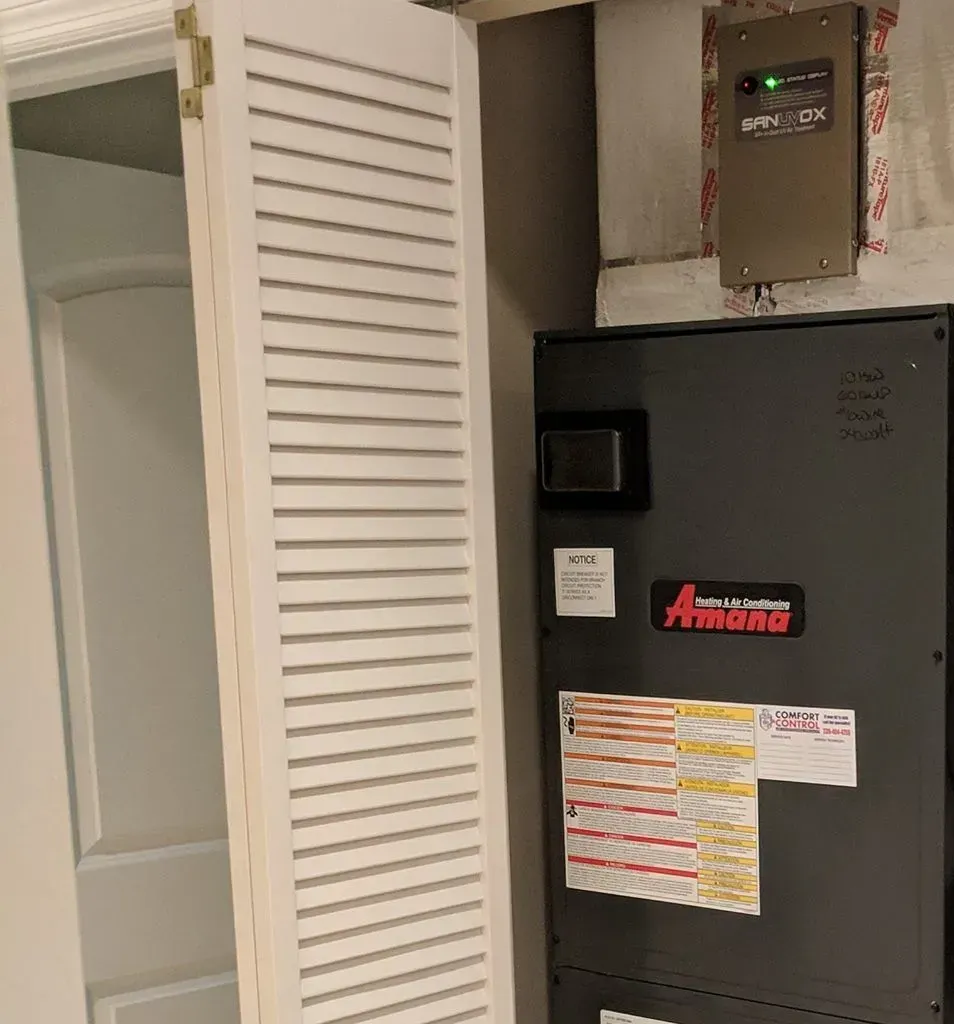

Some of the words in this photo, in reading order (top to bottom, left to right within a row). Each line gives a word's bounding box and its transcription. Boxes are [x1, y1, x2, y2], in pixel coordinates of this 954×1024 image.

[741, 106, 828, 132] SANUVOX
[568, 555, 597, 564] NOTICE
[663, 584, 792, 633] Amana
[695, 597, 723, 608] Heating
[724, 598, 730, 606] &
[730, 598, 741, 607] Air
[743, 598, 790, 610] Conditioning
[775, 711, 820, 720] COMFORT
[775, 719, 820, 729] CONTROL
